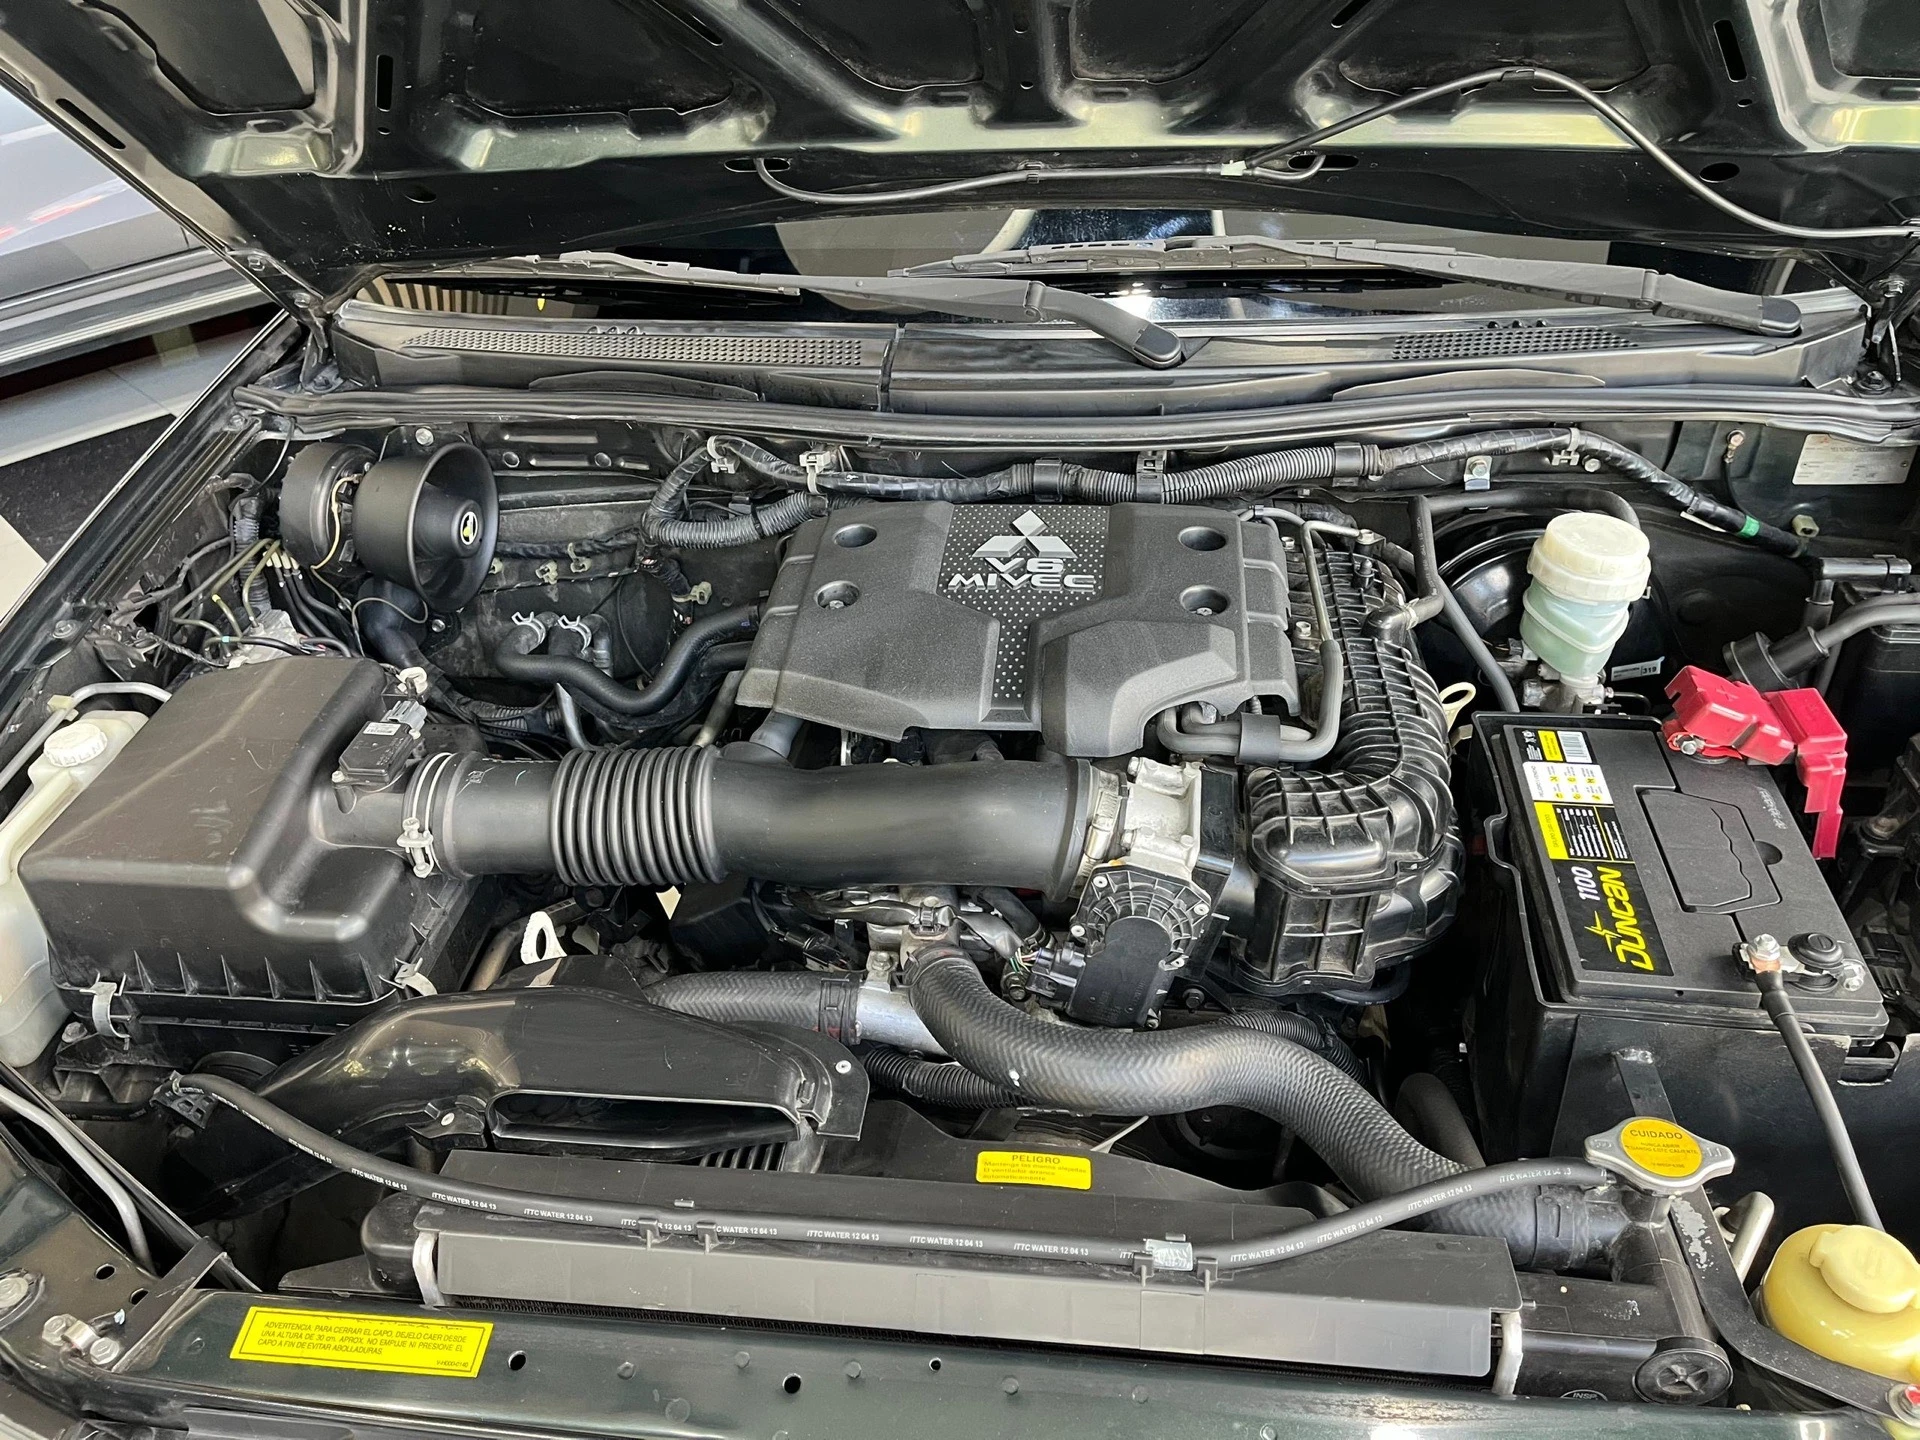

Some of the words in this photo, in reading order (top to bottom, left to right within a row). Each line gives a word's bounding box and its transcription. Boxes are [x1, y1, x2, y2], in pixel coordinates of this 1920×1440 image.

[984, 558, 1064, 574] V6
[948, 574, 1095, 592] MIVEC
[1571, 866, 1600, 900] 1100
[1630, 1130, 1683, 1139] CUIDADO
[1012, 1154, 1060, 1164] PELIGRO
[364, 1173, 384, 1184] WATER
[446, 1196, 470, 1206] WATER
[1423, 1192, 1446, 1205] WATER
[540, 1210, 565, 1219] WATER
[1333, 1224, 1357, 1239] WATER
[1358, 1221, 1365, 1229] 12
[1366, 1218, 1374, 1226] 04
[926, 1237, 954, 1245] WATER
[1031, 1244, 1058, 1253] WATER
[1080, 1248, 1089, 1256] 13
[1248, 1249, 1276, 1260] WATER
[444, 1335, 467, 1343] DESDE
[380, 1339, 407, 1347] EMPUJE
[418, 1342, 453, 1351] PRESIONE
